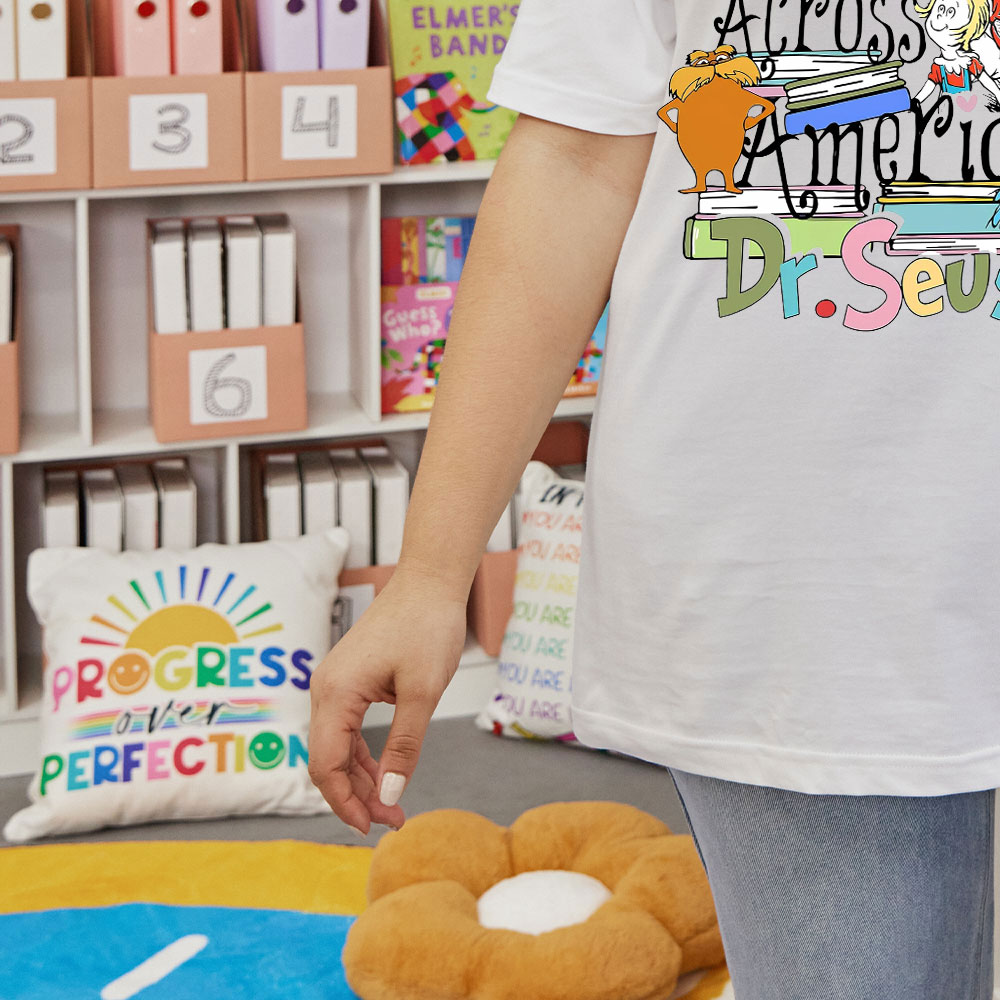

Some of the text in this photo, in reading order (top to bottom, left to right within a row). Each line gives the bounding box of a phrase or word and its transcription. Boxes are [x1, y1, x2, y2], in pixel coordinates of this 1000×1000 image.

[429, 33, 509, 59] BAND
[0, 113, 35, 165] 2
[152, 102, 192, 155] 3
[291, 96, 339, 149] 4
[710, 216, 837, 319] Dr.
[383, 306, 438, 328] Guess
[388, 319, 442, 343] Who?
[204, 352, 252, 418] 6
[514, 600, 574, 628] OU ARE
[52, 646, 313, 714] PROGRESS
[531, 667, 565, 692] ARE
[116, 699, 247, 735] over
[530, 698, 562, 721] ARE
[39, 731, 310, 797] PERFECTION
